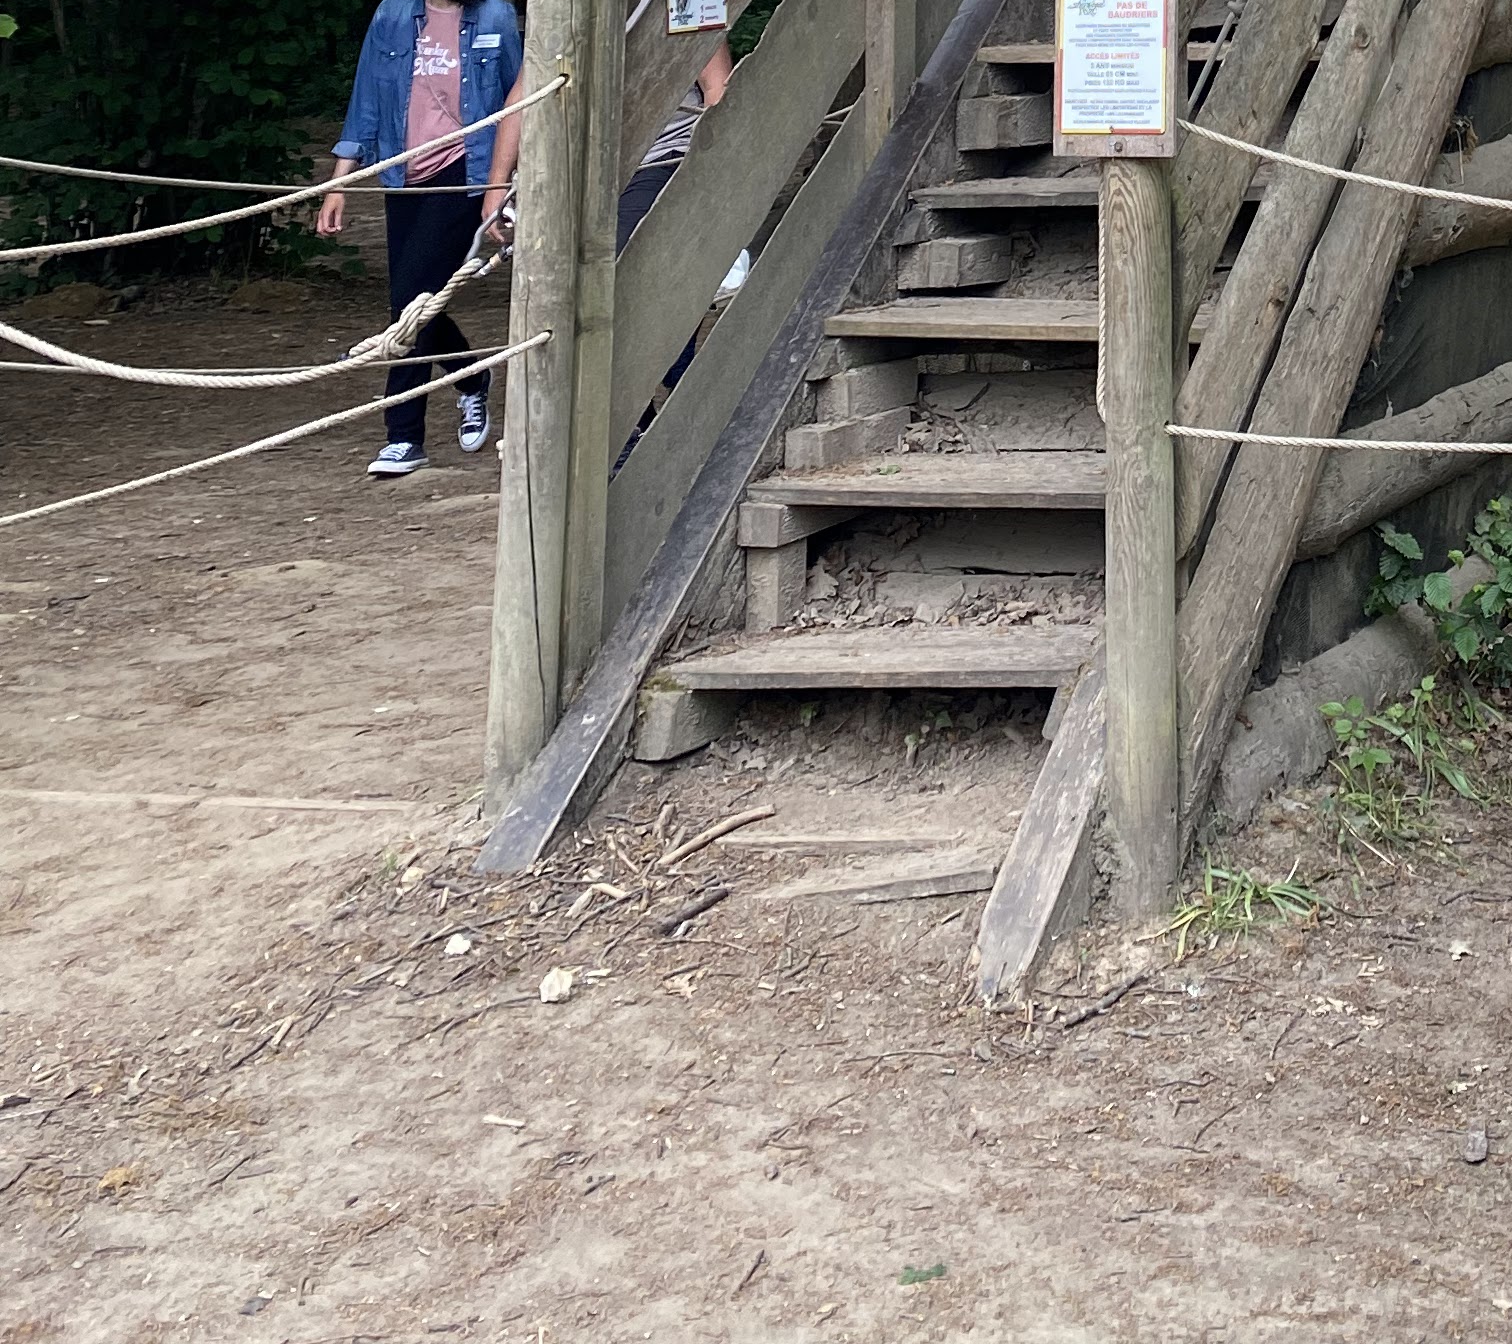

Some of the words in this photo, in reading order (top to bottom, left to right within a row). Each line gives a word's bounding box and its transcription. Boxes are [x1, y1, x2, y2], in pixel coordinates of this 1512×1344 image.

[1116, 1, 1133, 10] PAS
[1135, 0, 1148, 10] DE
[1107, 10, 1158, 19] BAUDRIERS
